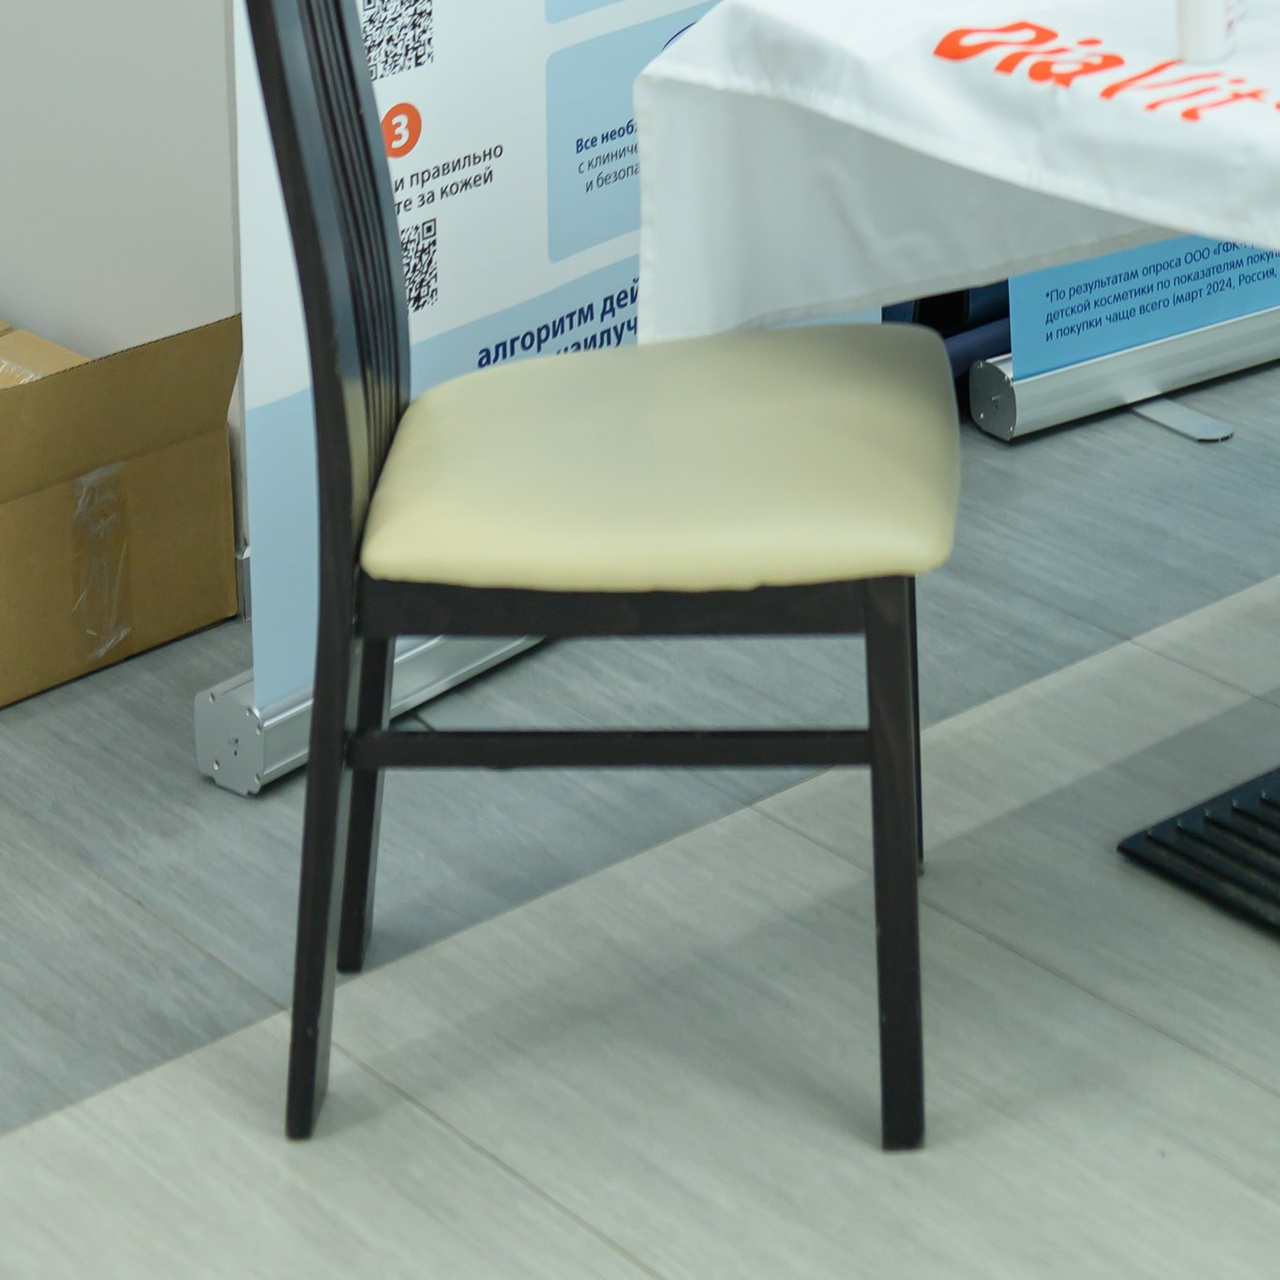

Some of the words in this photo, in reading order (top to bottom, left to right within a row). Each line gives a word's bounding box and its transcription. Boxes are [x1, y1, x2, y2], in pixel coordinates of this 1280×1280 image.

[391, 114, 410, 149] 3
[576, 136, 598, 154] Все
[410, 144, 503, 188] правильно
[578, 161, 584, 174] с
[585, 179, 593, 193] и
[417, 190, 435, 208] за
[440, 169, 493, 200] кожей
[1044, 298, 1091, 326] детской
[1093, 283, 1154, 309] косметики
[1156, 278, 1170, 291] по
[1173, 258, 1244, 287] показателям
[1068, 268, 1139, 300] результатам
[1141, 257, 1181, 277] опроса
[1184, 246, 1210, 264] ООО
[1045, 330, 1053, 342] и
[1056, 316, 1102, 339] покупки
[1105, 307, 1136, 323] чаще
[1138, 297, 1170, 315] всего
[1206, 276, 1236, 296] 2024,
[1238, 266, 1278, 288] Россия,
[477, 302, 594, 369] алгоритм
